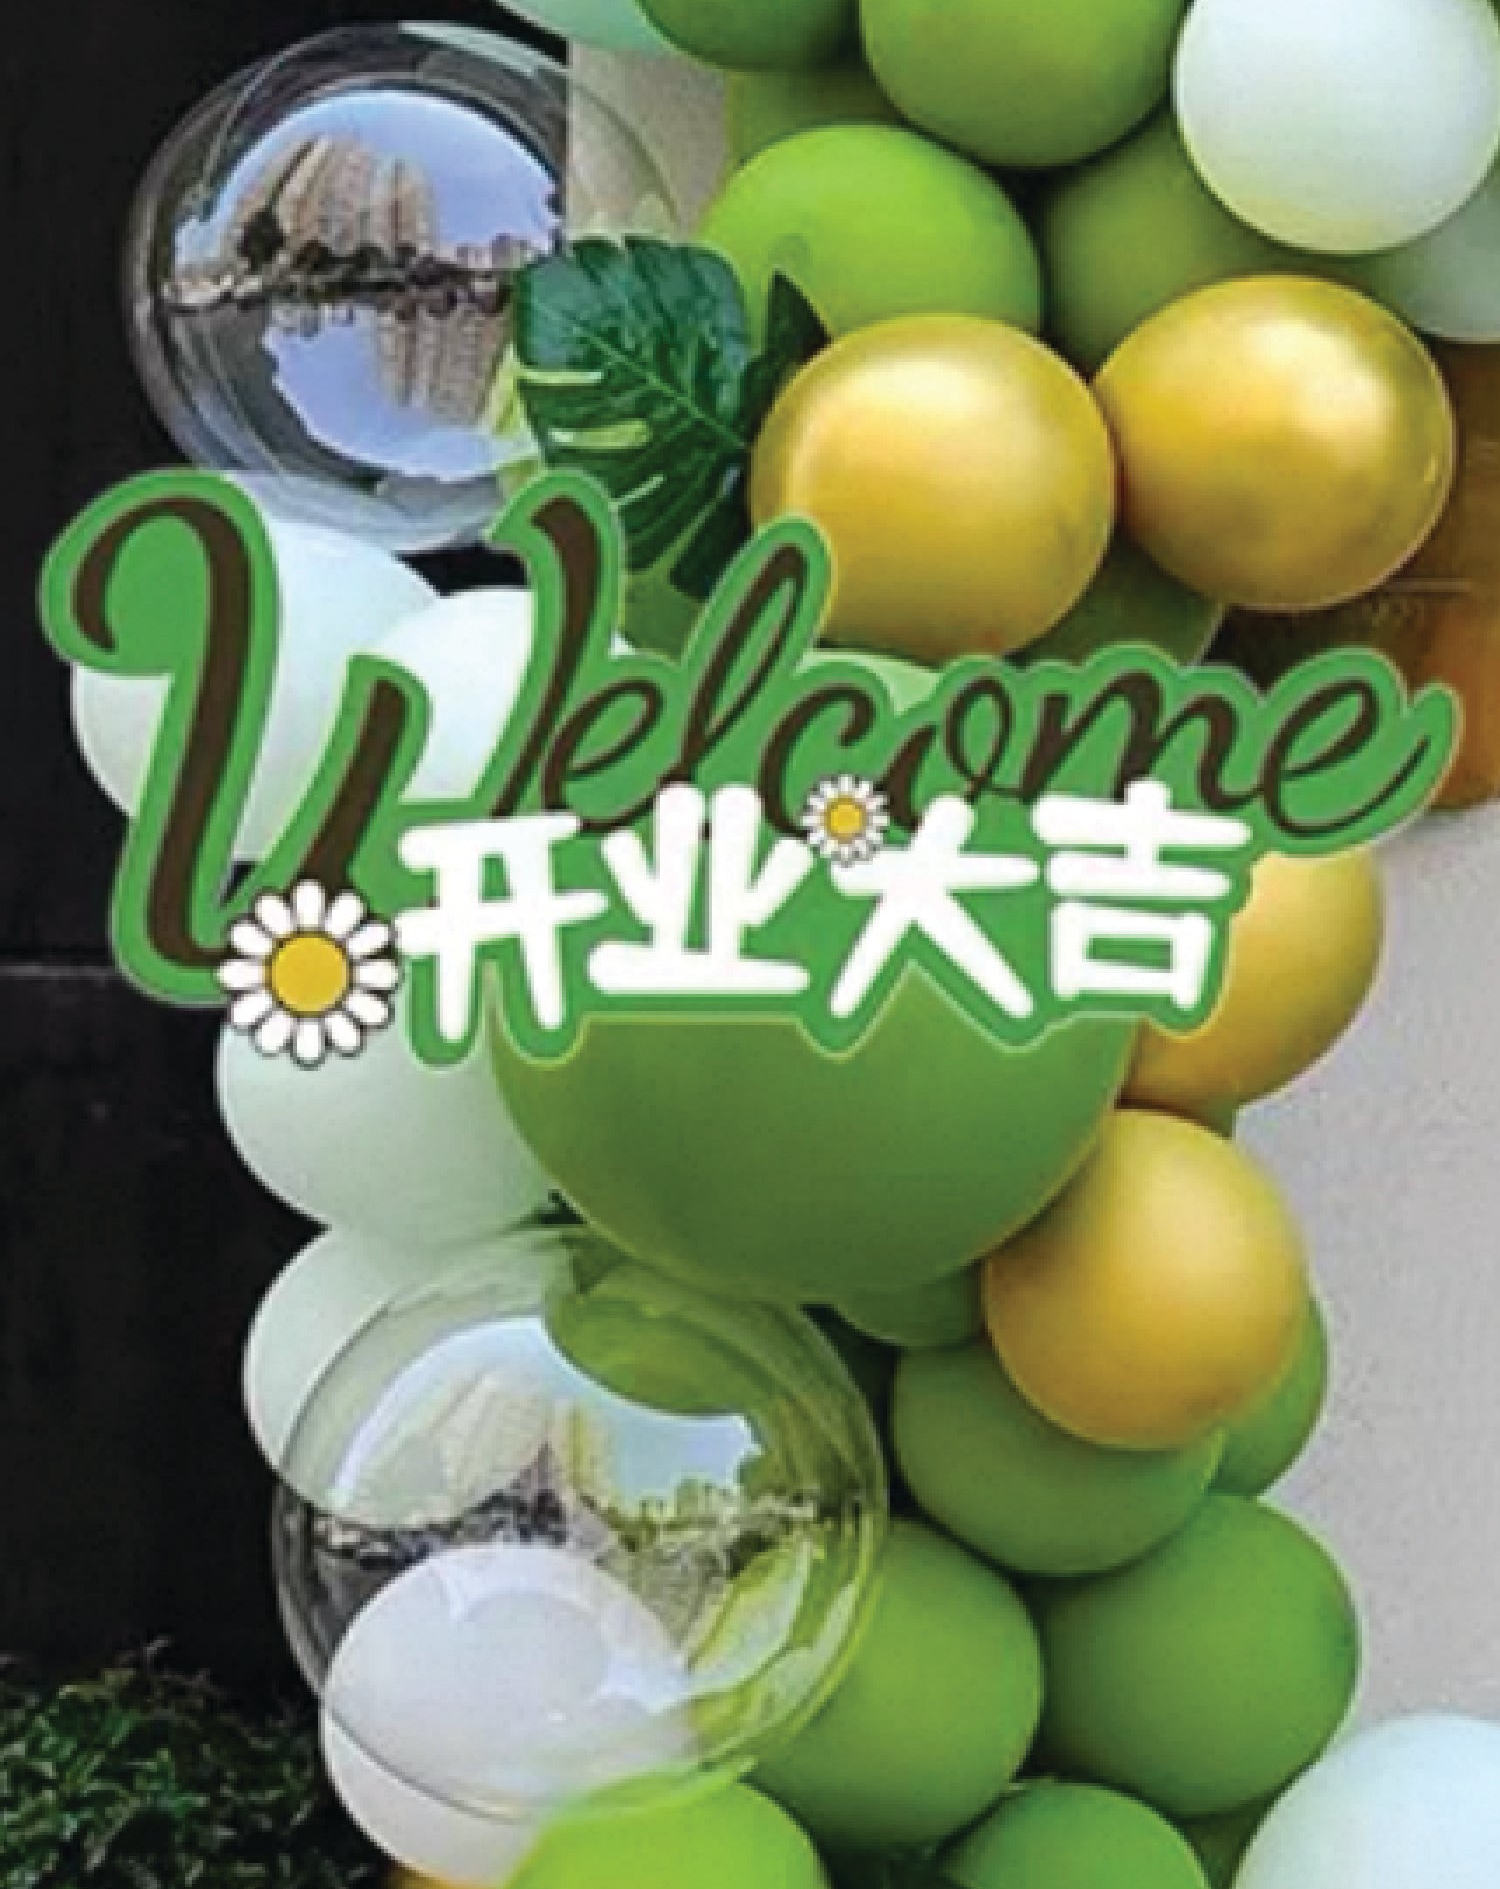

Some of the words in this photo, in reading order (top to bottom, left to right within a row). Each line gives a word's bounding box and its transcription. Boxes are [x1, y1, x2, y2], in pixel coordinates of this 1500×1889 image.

[68, 494, 1434, 968] Welcome
[398, 778, 1254, 1042] 开业大吉
